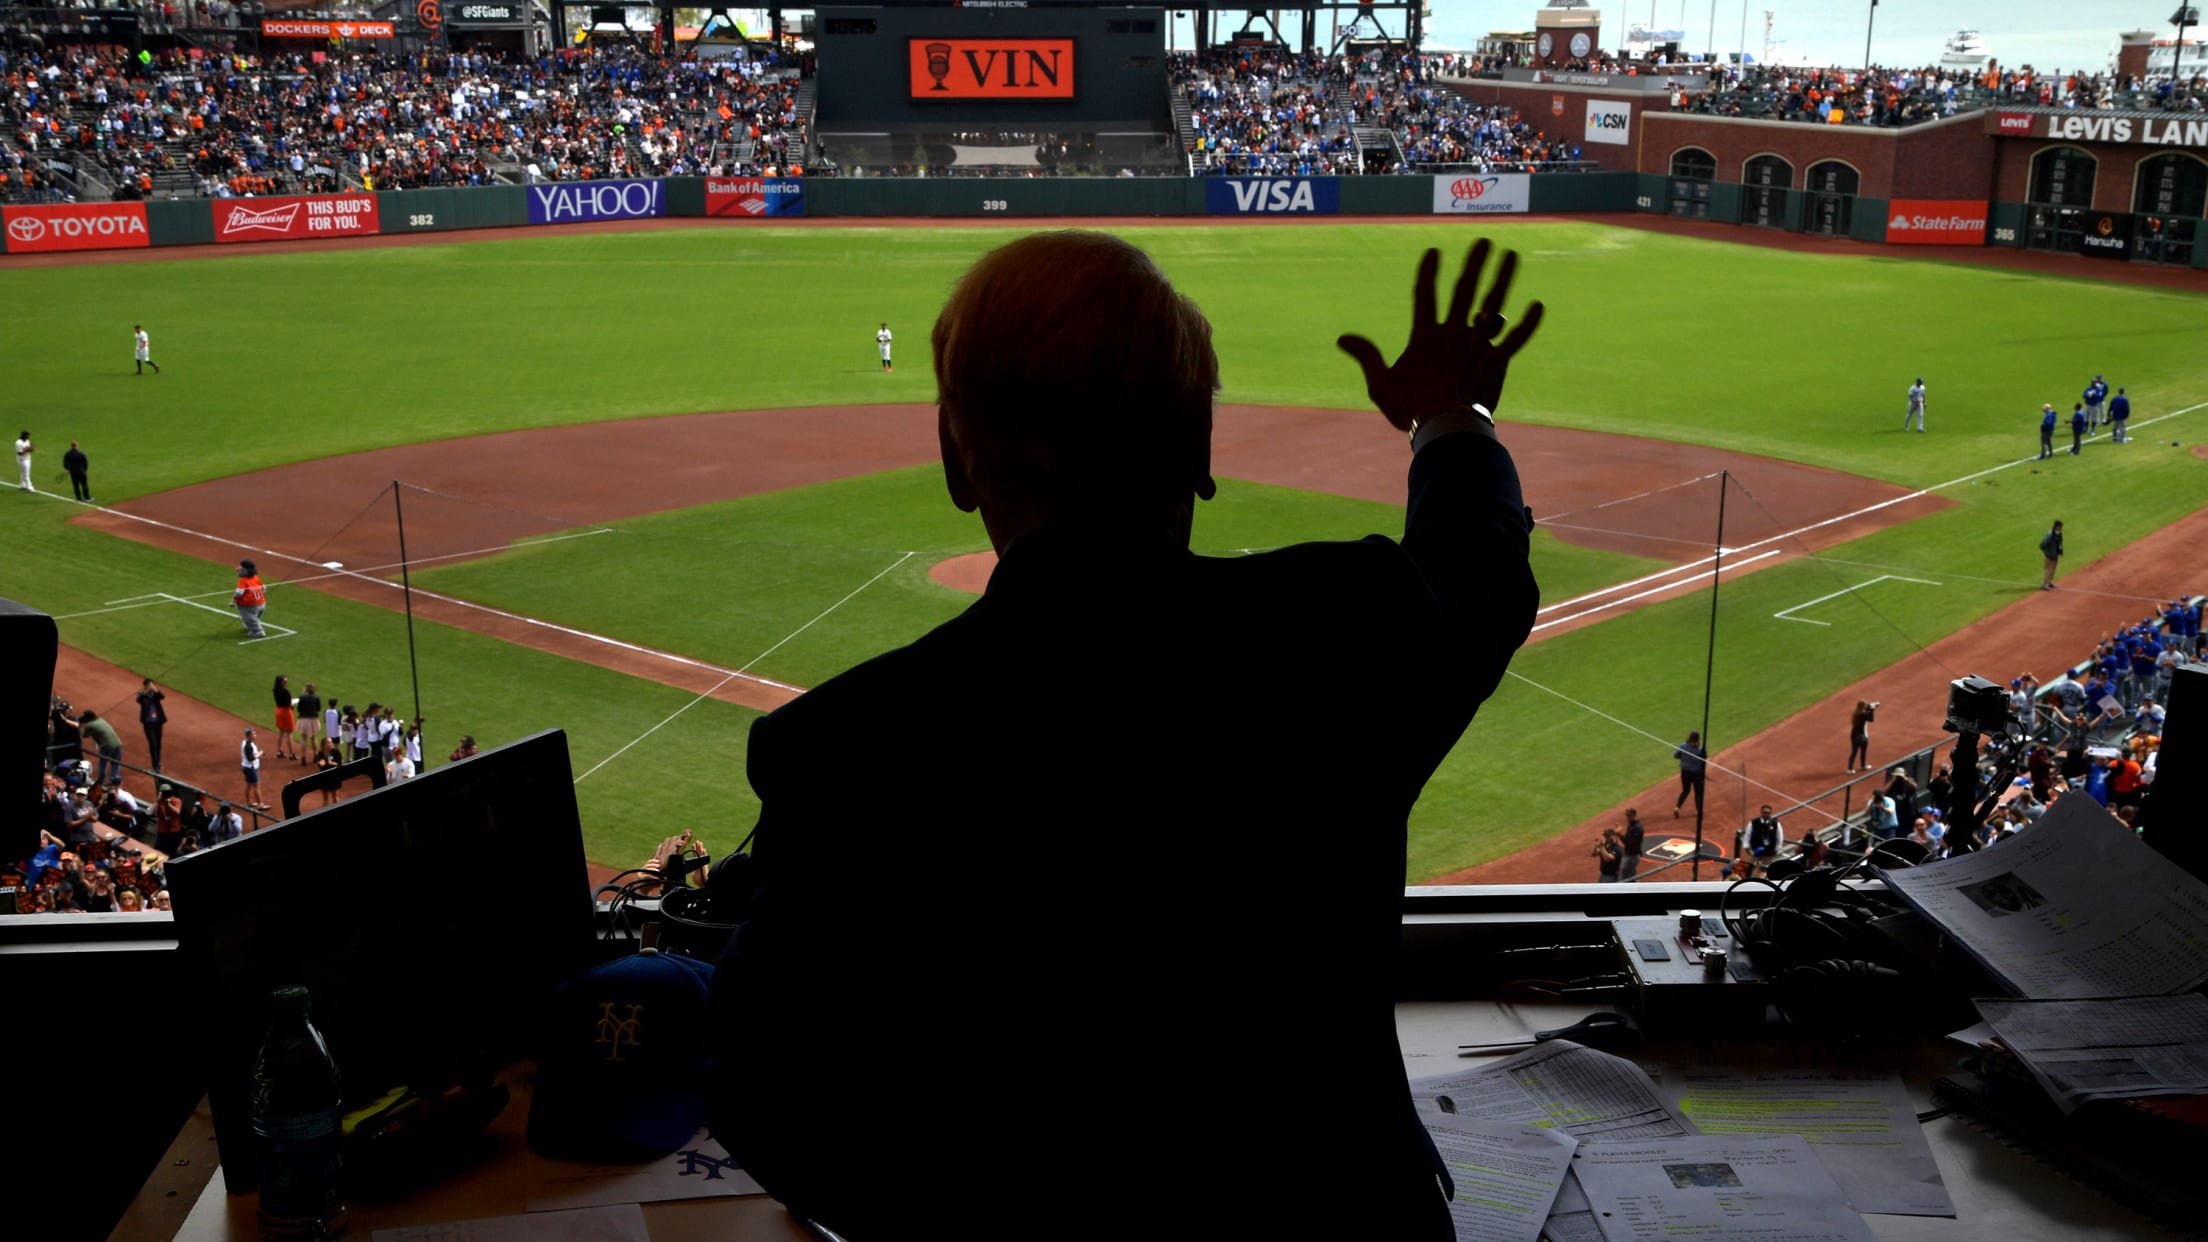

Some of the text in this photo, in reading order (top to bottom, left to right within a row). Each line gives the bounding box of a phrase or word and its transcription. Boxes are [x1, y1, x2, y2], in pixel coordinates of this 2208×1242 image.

[462, 6, 509, 18] @SFGiants
[265, 24, 391, 35] DOCKERS DECK
[961, 50, 1062, 88] VIN
[1603, 114, 1627, 129] CSN
[708, 182, 800, 193] Bank of America
[1454, 180, 1483, 199] AAA
[534, 181, 658, 222] YAHOO!
[1225, 180, 1315, 211] VISA
[1637, 196, 1652, 208] 421
[306, 199, 371, 215] THIS BUD'S
[983, 200, 1007, 210] 399
[1466, 203, 1512, 211] Insurance
[48, 216, 146, 237] TOYOTA
[229, 211, 293, 227] Budweiser
[308, 215, 361, 231] FOR YOU.
[409, 214, 434, 226] 382
[1911, 215, 1985, 231] State Farm
[1995, 228, 2015, 240] 365
[2084, 234, 2124, 249] Hanwha
